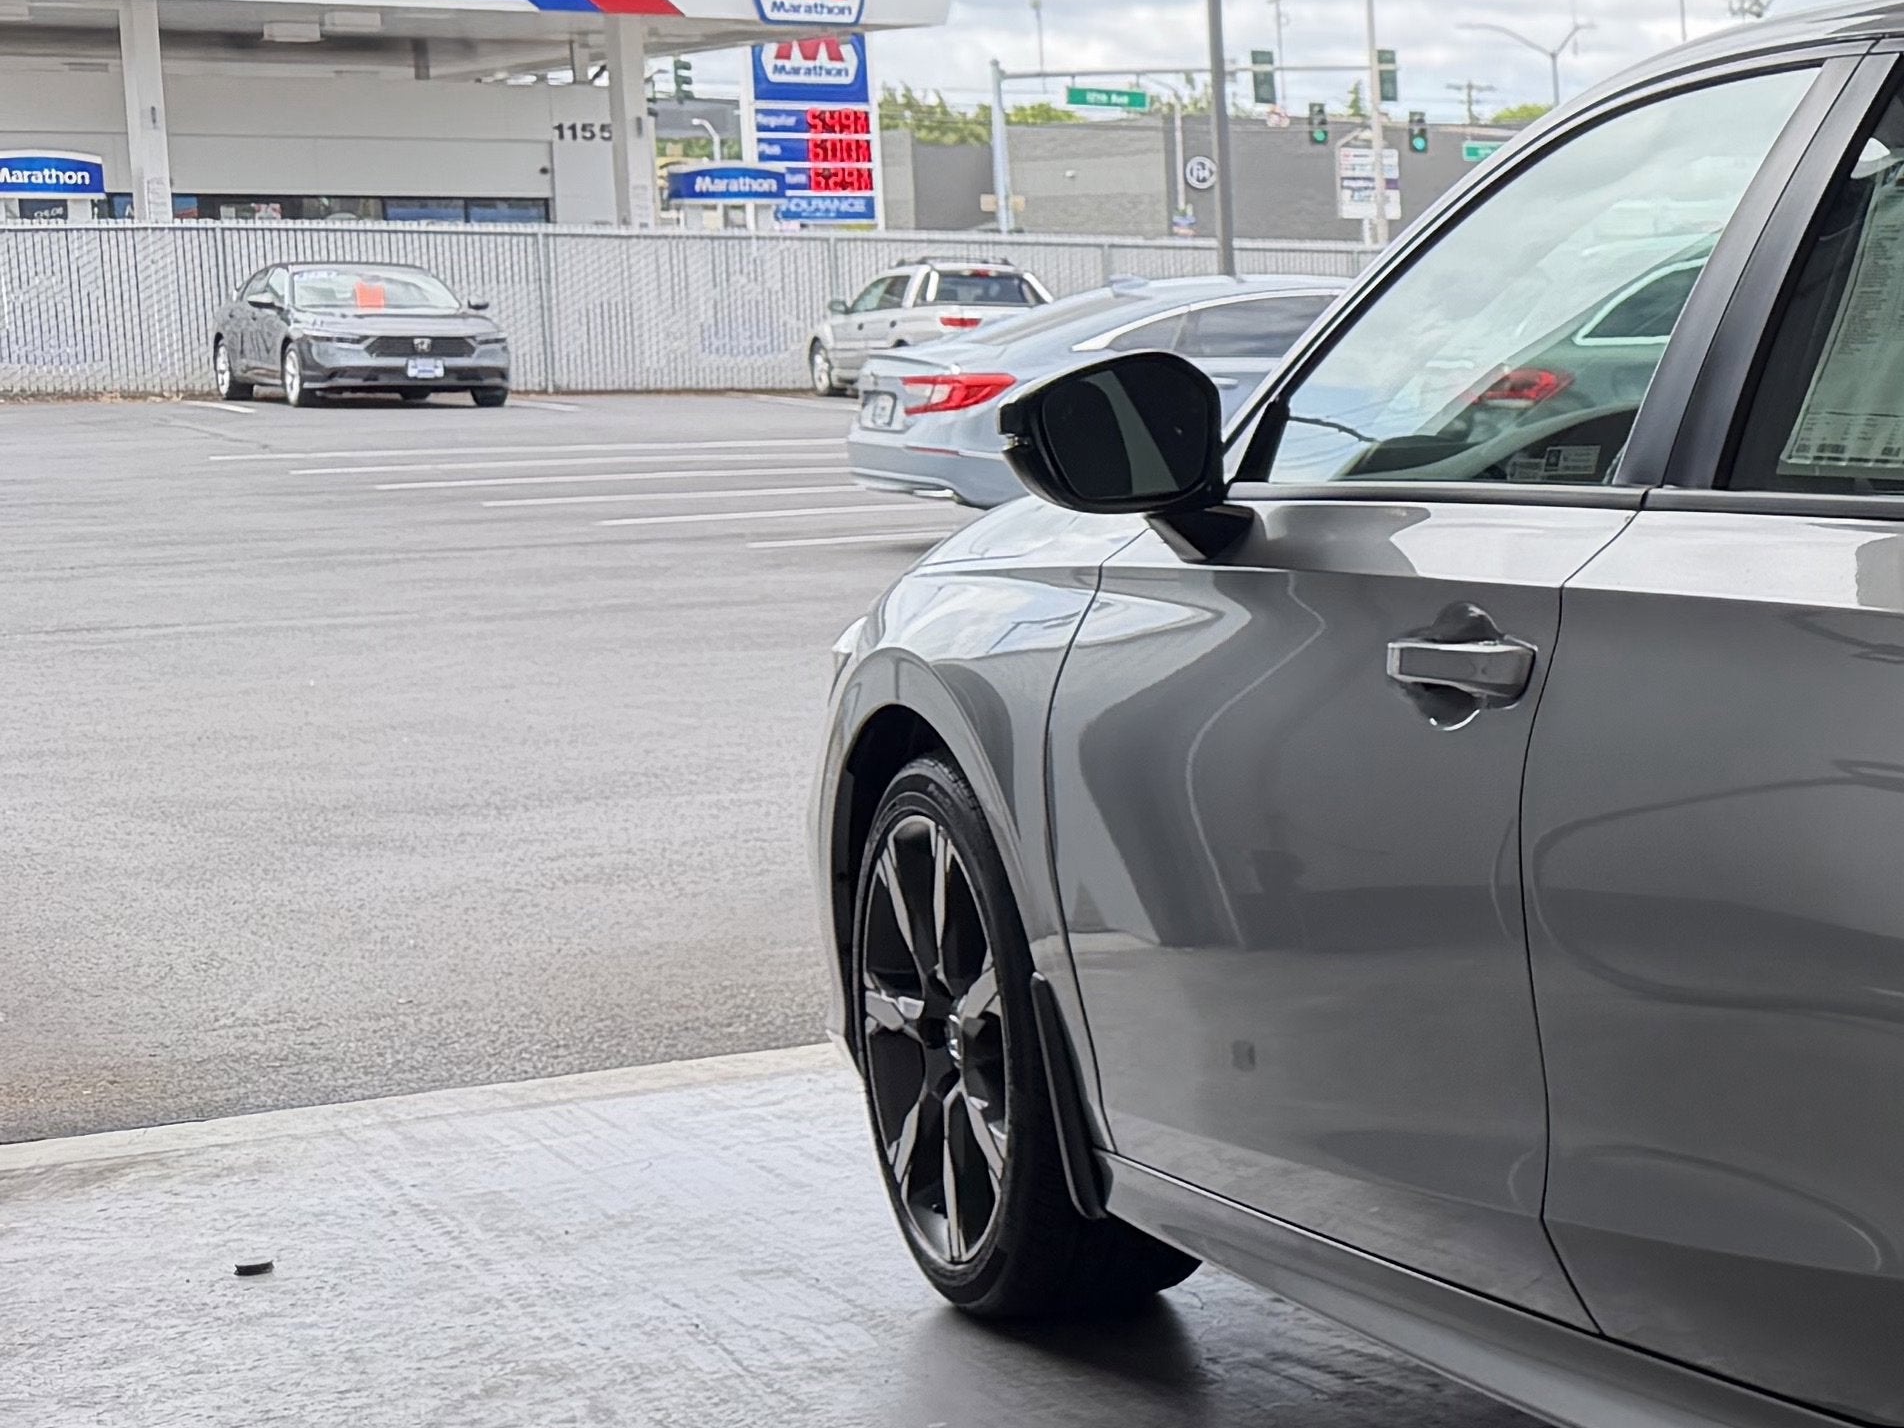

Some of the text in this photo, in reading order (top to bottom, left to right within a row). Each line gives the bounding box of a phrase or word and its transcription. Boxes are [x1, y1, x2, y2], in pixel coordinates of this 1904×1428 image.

[771, 1, 852, 16] Marathon
[772, 63, 849, 78] Marathon
[553, 122, 613, 141] 1155
[694, 175, 778, 193] Marathon
